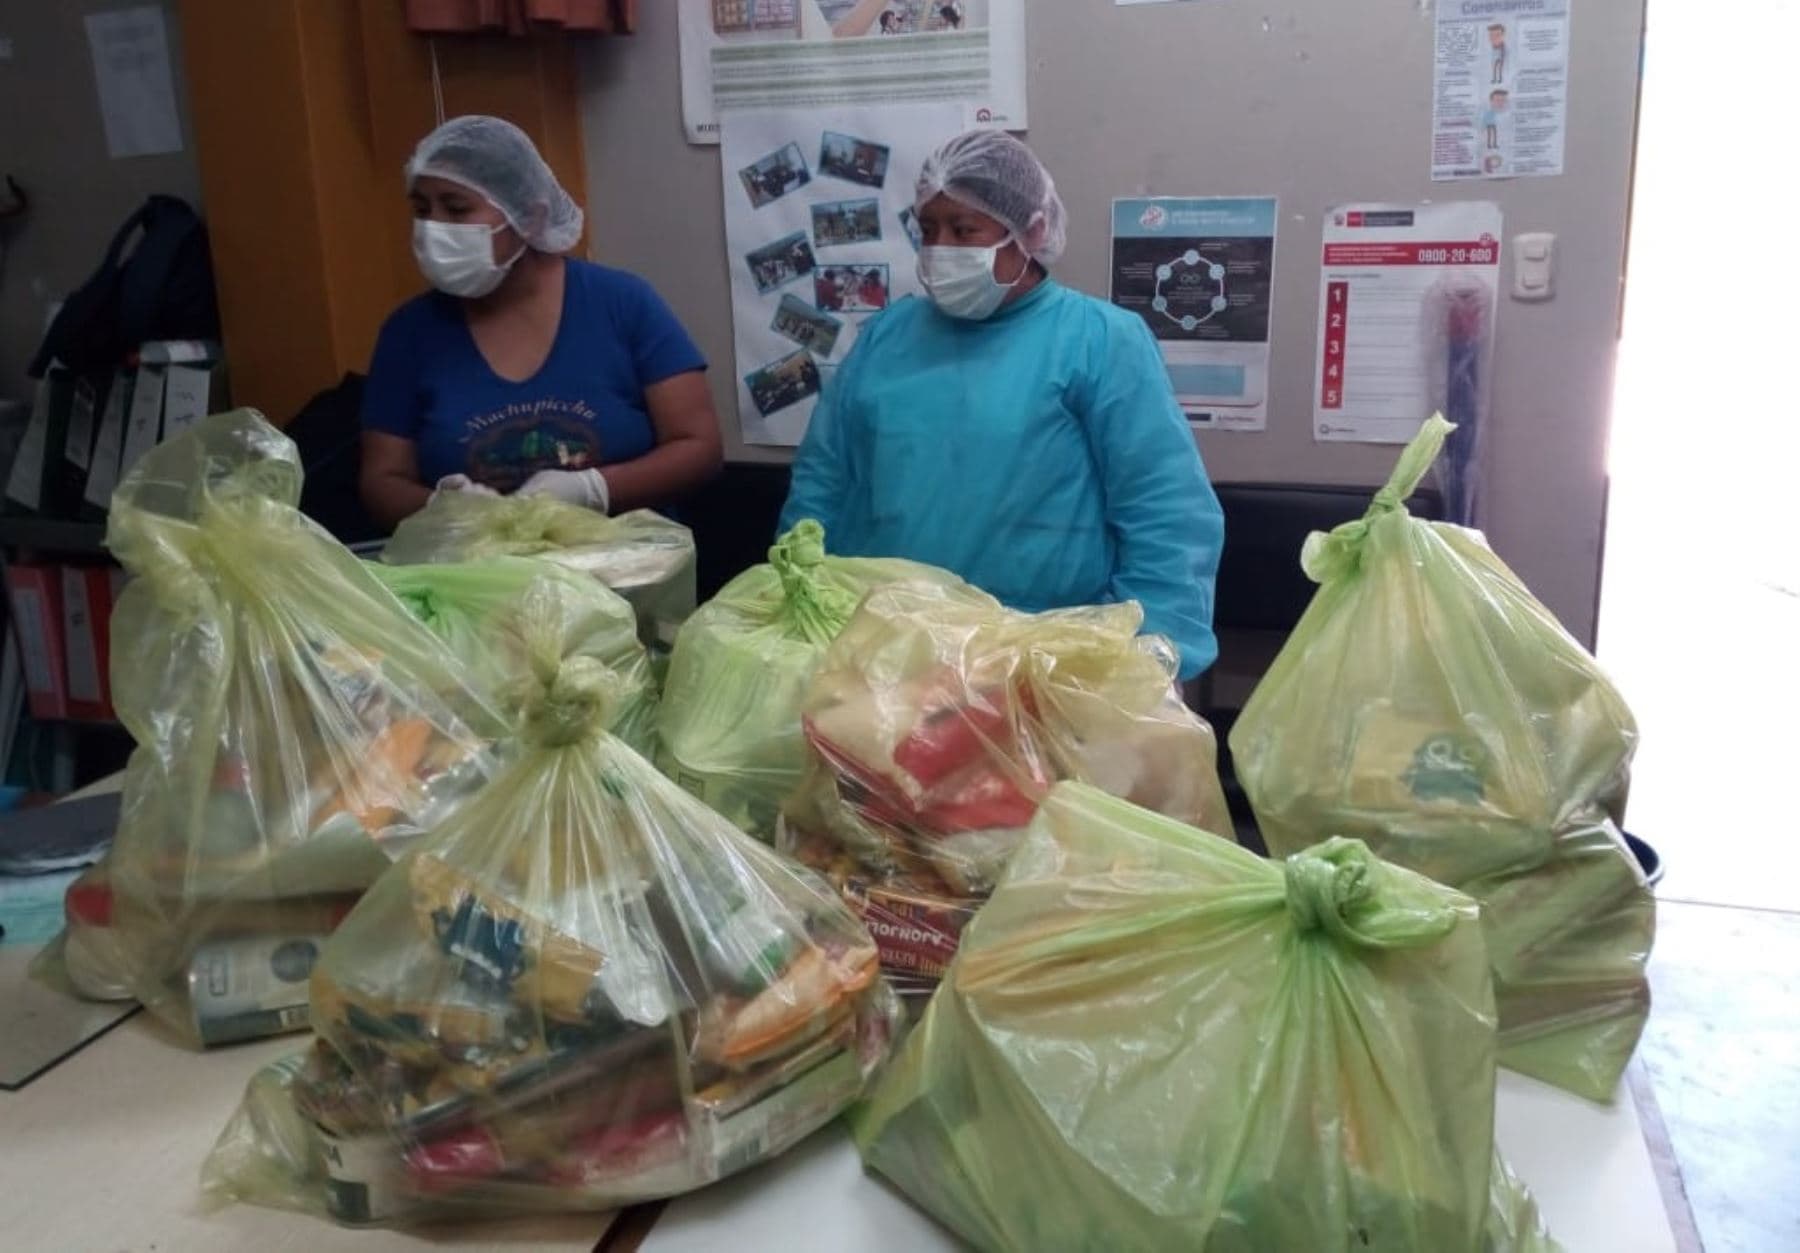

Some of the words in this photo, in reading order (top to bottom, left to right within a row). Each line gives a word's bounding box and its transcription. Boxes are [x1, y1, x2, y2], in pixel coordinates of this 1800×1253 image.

[1333, 289, 1341, 302] 1
[1331, 313, 1341, 327] 2
[1330, 341, 1339, 354] 3
[1328, 365, 1338, 377] 4
[1327, 391, 1336, 402] 5
